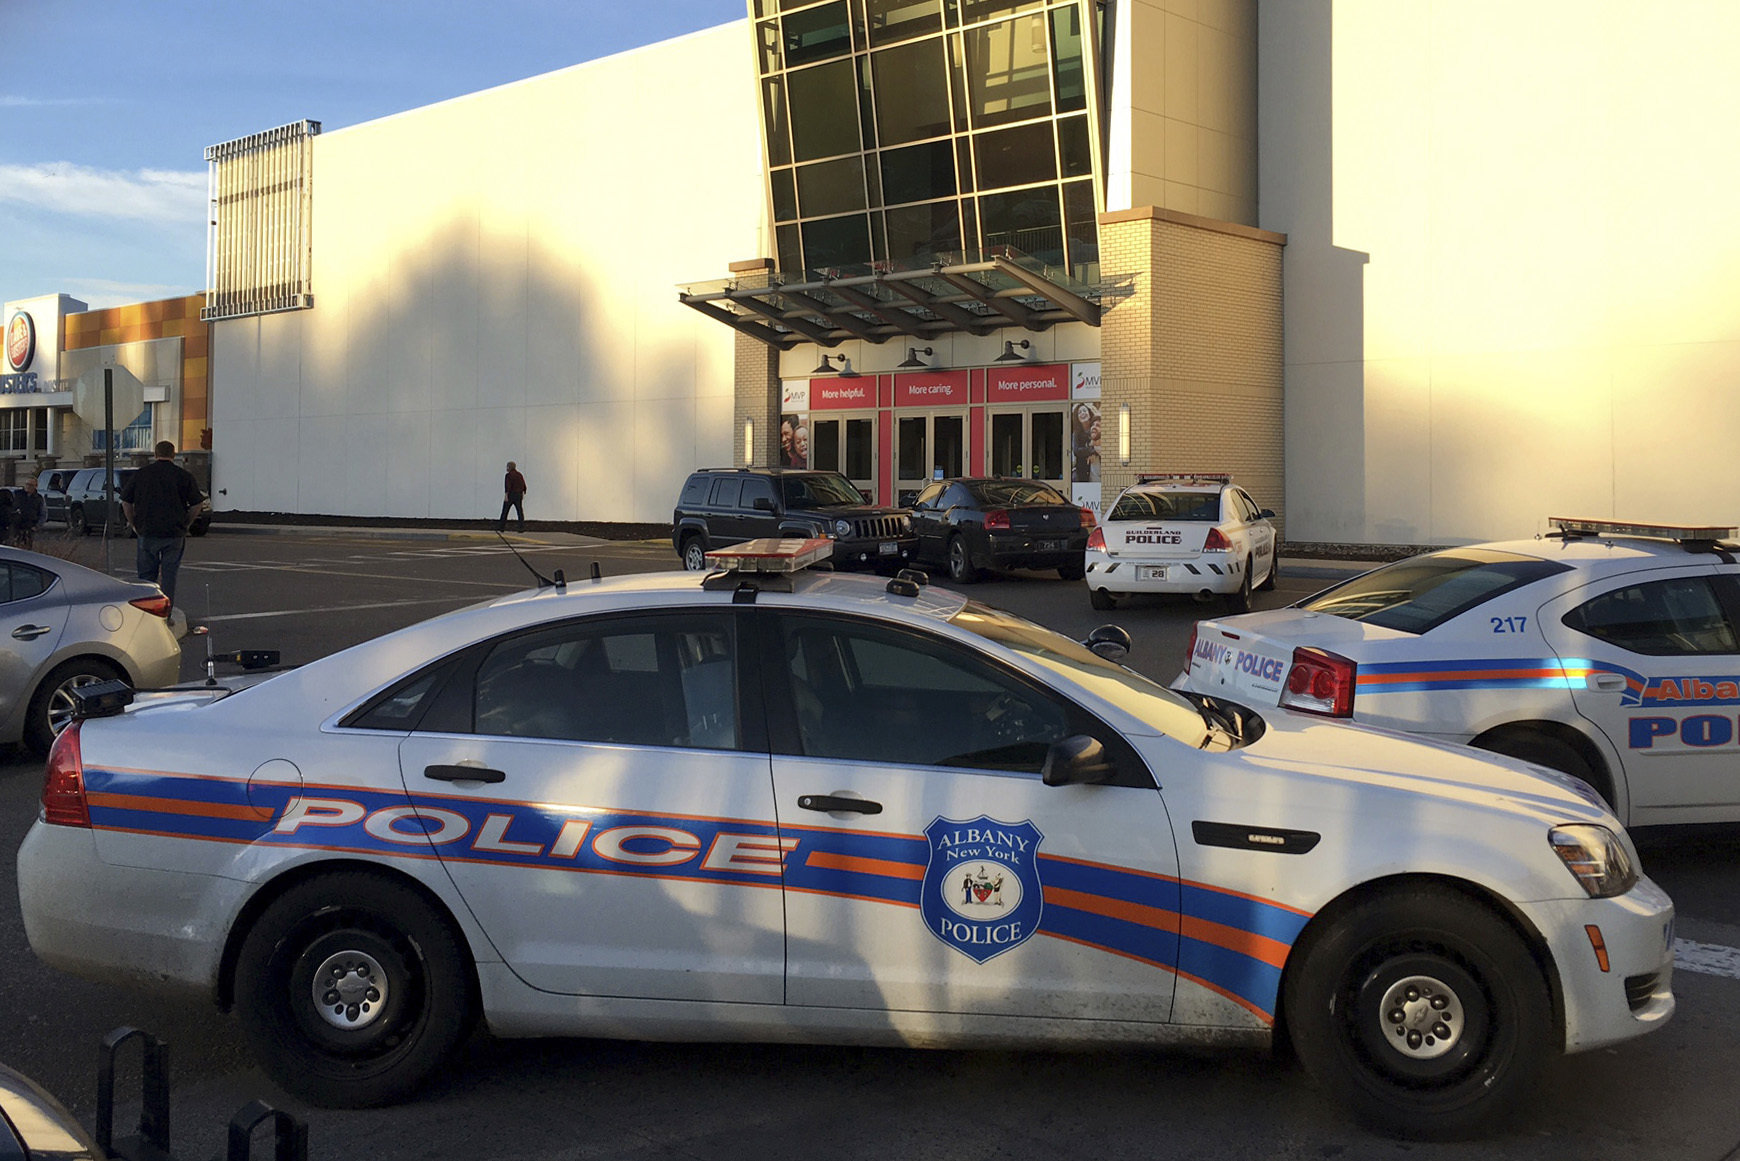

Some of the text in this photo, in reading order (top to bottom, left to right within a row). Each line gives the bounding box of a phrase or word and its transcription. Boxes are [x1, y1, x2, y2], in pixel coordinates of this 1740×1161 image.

[908, 383, 954, 396] More caring.
[997, 377, 1057, 392] More personal.
[791, 391, 807, 400] MVP
[821, 387, 866, 401] More helpful.
[1085, 501, 1102, 511] MV
[1125, 535, 1183, 545] POLICE
[1490, 616, 1528, 633] 217
[1193, 638, 1285, 683] ALBANY POLICE
[1656, 678, 1740, 702] Alba
[1628, 713, 1740, 749] PO
[271, 796, 801, 876] POLICE
[937, 828, 1030, 853] ALBANY
[946, 845, 1020, 865] New York
[940, 917, 1023, 945] POLICE
